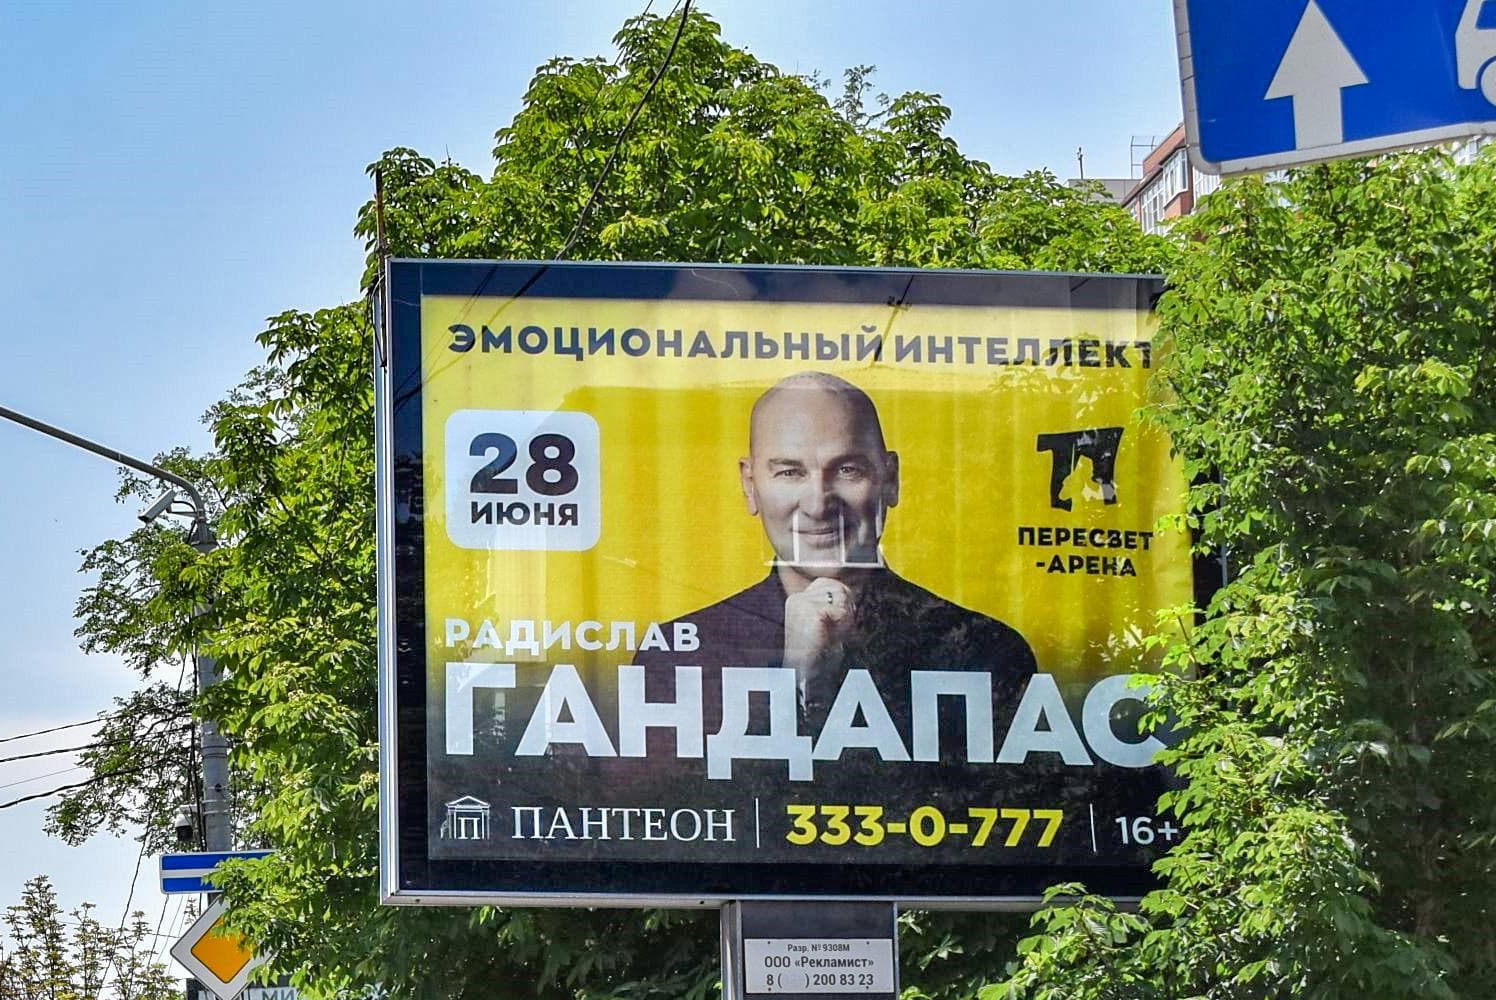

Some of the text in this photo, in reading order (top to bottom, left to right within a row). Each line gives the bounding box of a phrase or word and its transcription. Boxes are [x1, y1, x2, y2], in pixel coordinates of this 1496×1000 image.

[447, 323, 1152, 370] ЭМОЦИОНАЛЬНЫЙ ИНТЕЛЛЕКТ
[468, 432, 580, 497] 28
[470, 501, 579, 527] ИЮНЯ
[1017, 526, 1154, 551] ПЕРЕСВЕТ
[1035, 555, 1137, 578] -АРЕНА
[444, 618, 701, 657] РАДИСЛАВ
[445, 662, 1168, 782] ГАНДАПАС
[510, 805, 737, 842] ПАНТЕОН
[785, 804, 1064, 848] 333-0-777
[1115, 816, 1179, 846] 16+
[787, 943, 809, 953] Разр.
[764, 955, 875, 968] ООО «Рекламист»
[812, 973, 836, 986] 200
[839, 973, 855, 986] 83
[858, 973, 874, 986] 23
